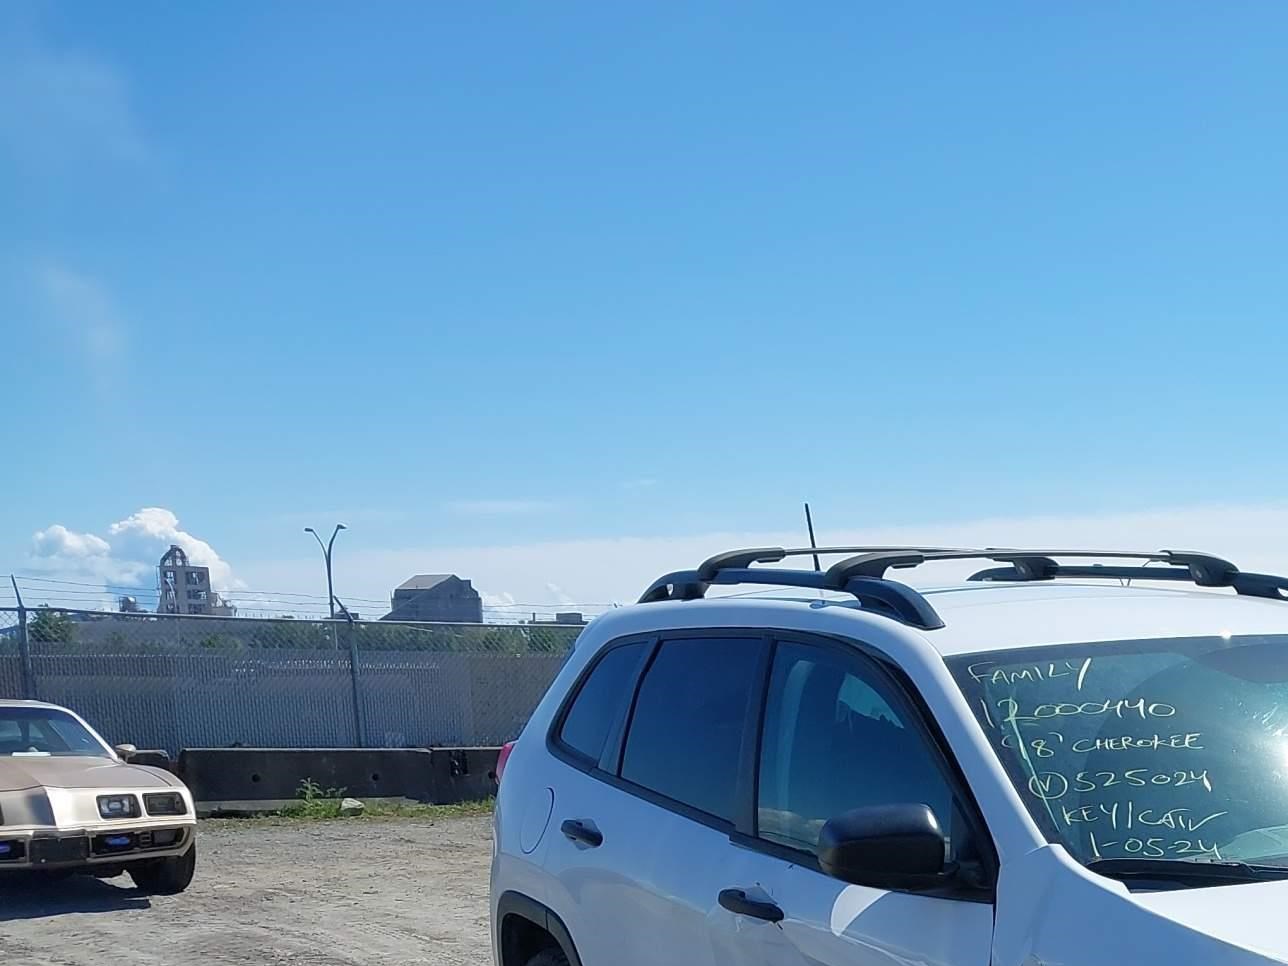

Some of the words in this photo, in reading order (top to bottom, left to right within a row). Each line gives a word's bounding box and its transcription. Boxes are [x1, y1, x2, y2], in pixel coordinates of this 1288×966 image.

[967, 657, 1092, 691] FAMILY
[1072, 732, 1204, 752] CHEROKEE
[1090, 831, 1222, 860] 1-05-24
